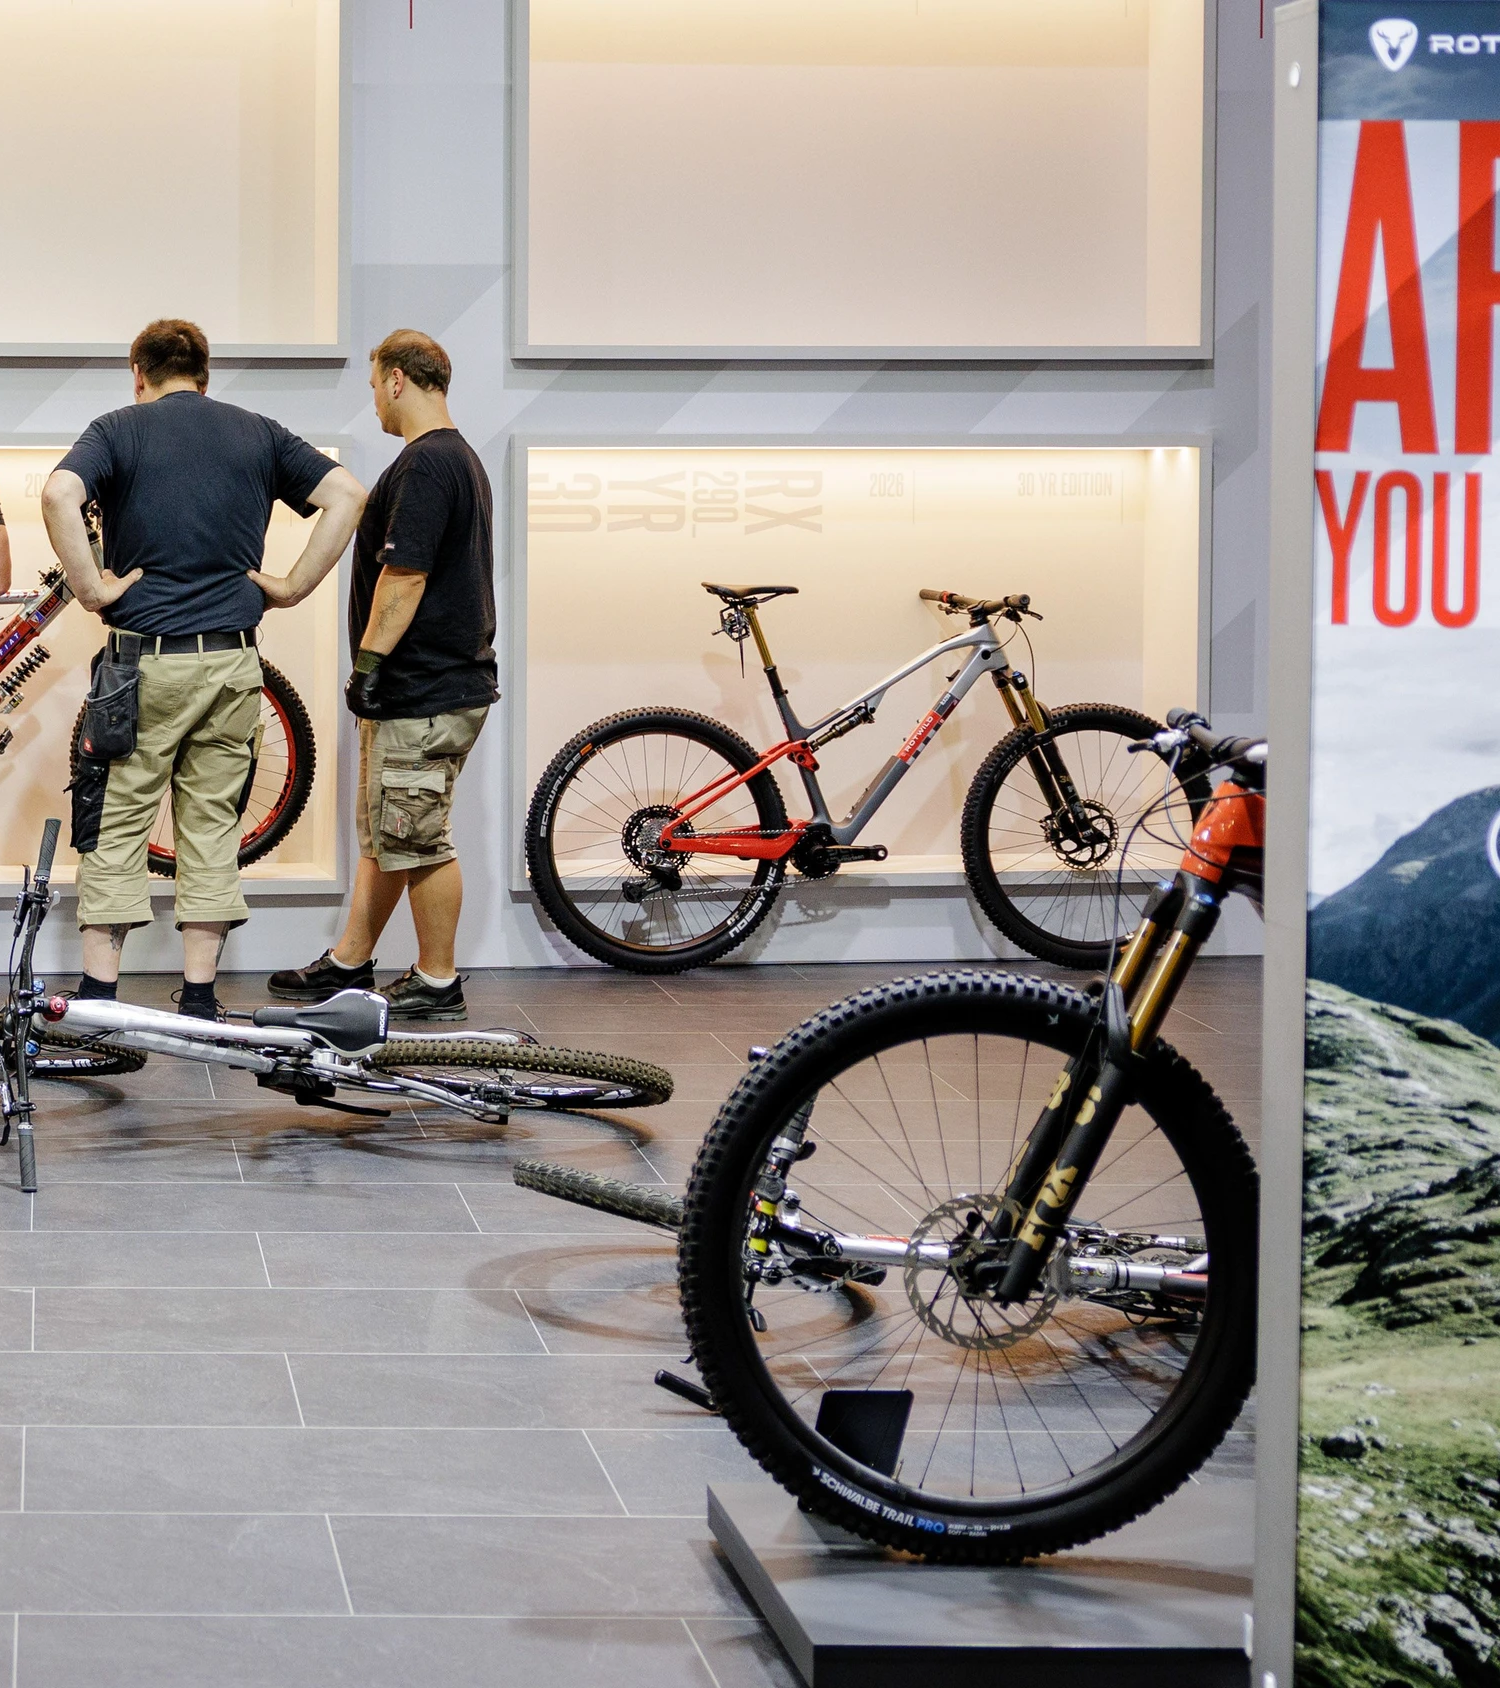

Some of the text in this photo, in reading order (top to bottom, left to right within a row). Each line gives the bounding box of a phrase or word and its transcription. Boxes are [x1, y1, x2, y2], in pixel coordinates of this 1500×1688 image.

[869, 472, 905, 498] 2026
[1017, 472, 1113, 497] 30 YR EDITION
[1315, 469, 1482, 628] YOU
[904, 716, 934, 752] ROTWILD
[540, 752, 581, 838] SCHWALBE
[819, 1471, 945, 1533] SCHWALBE TRAIL PRO
